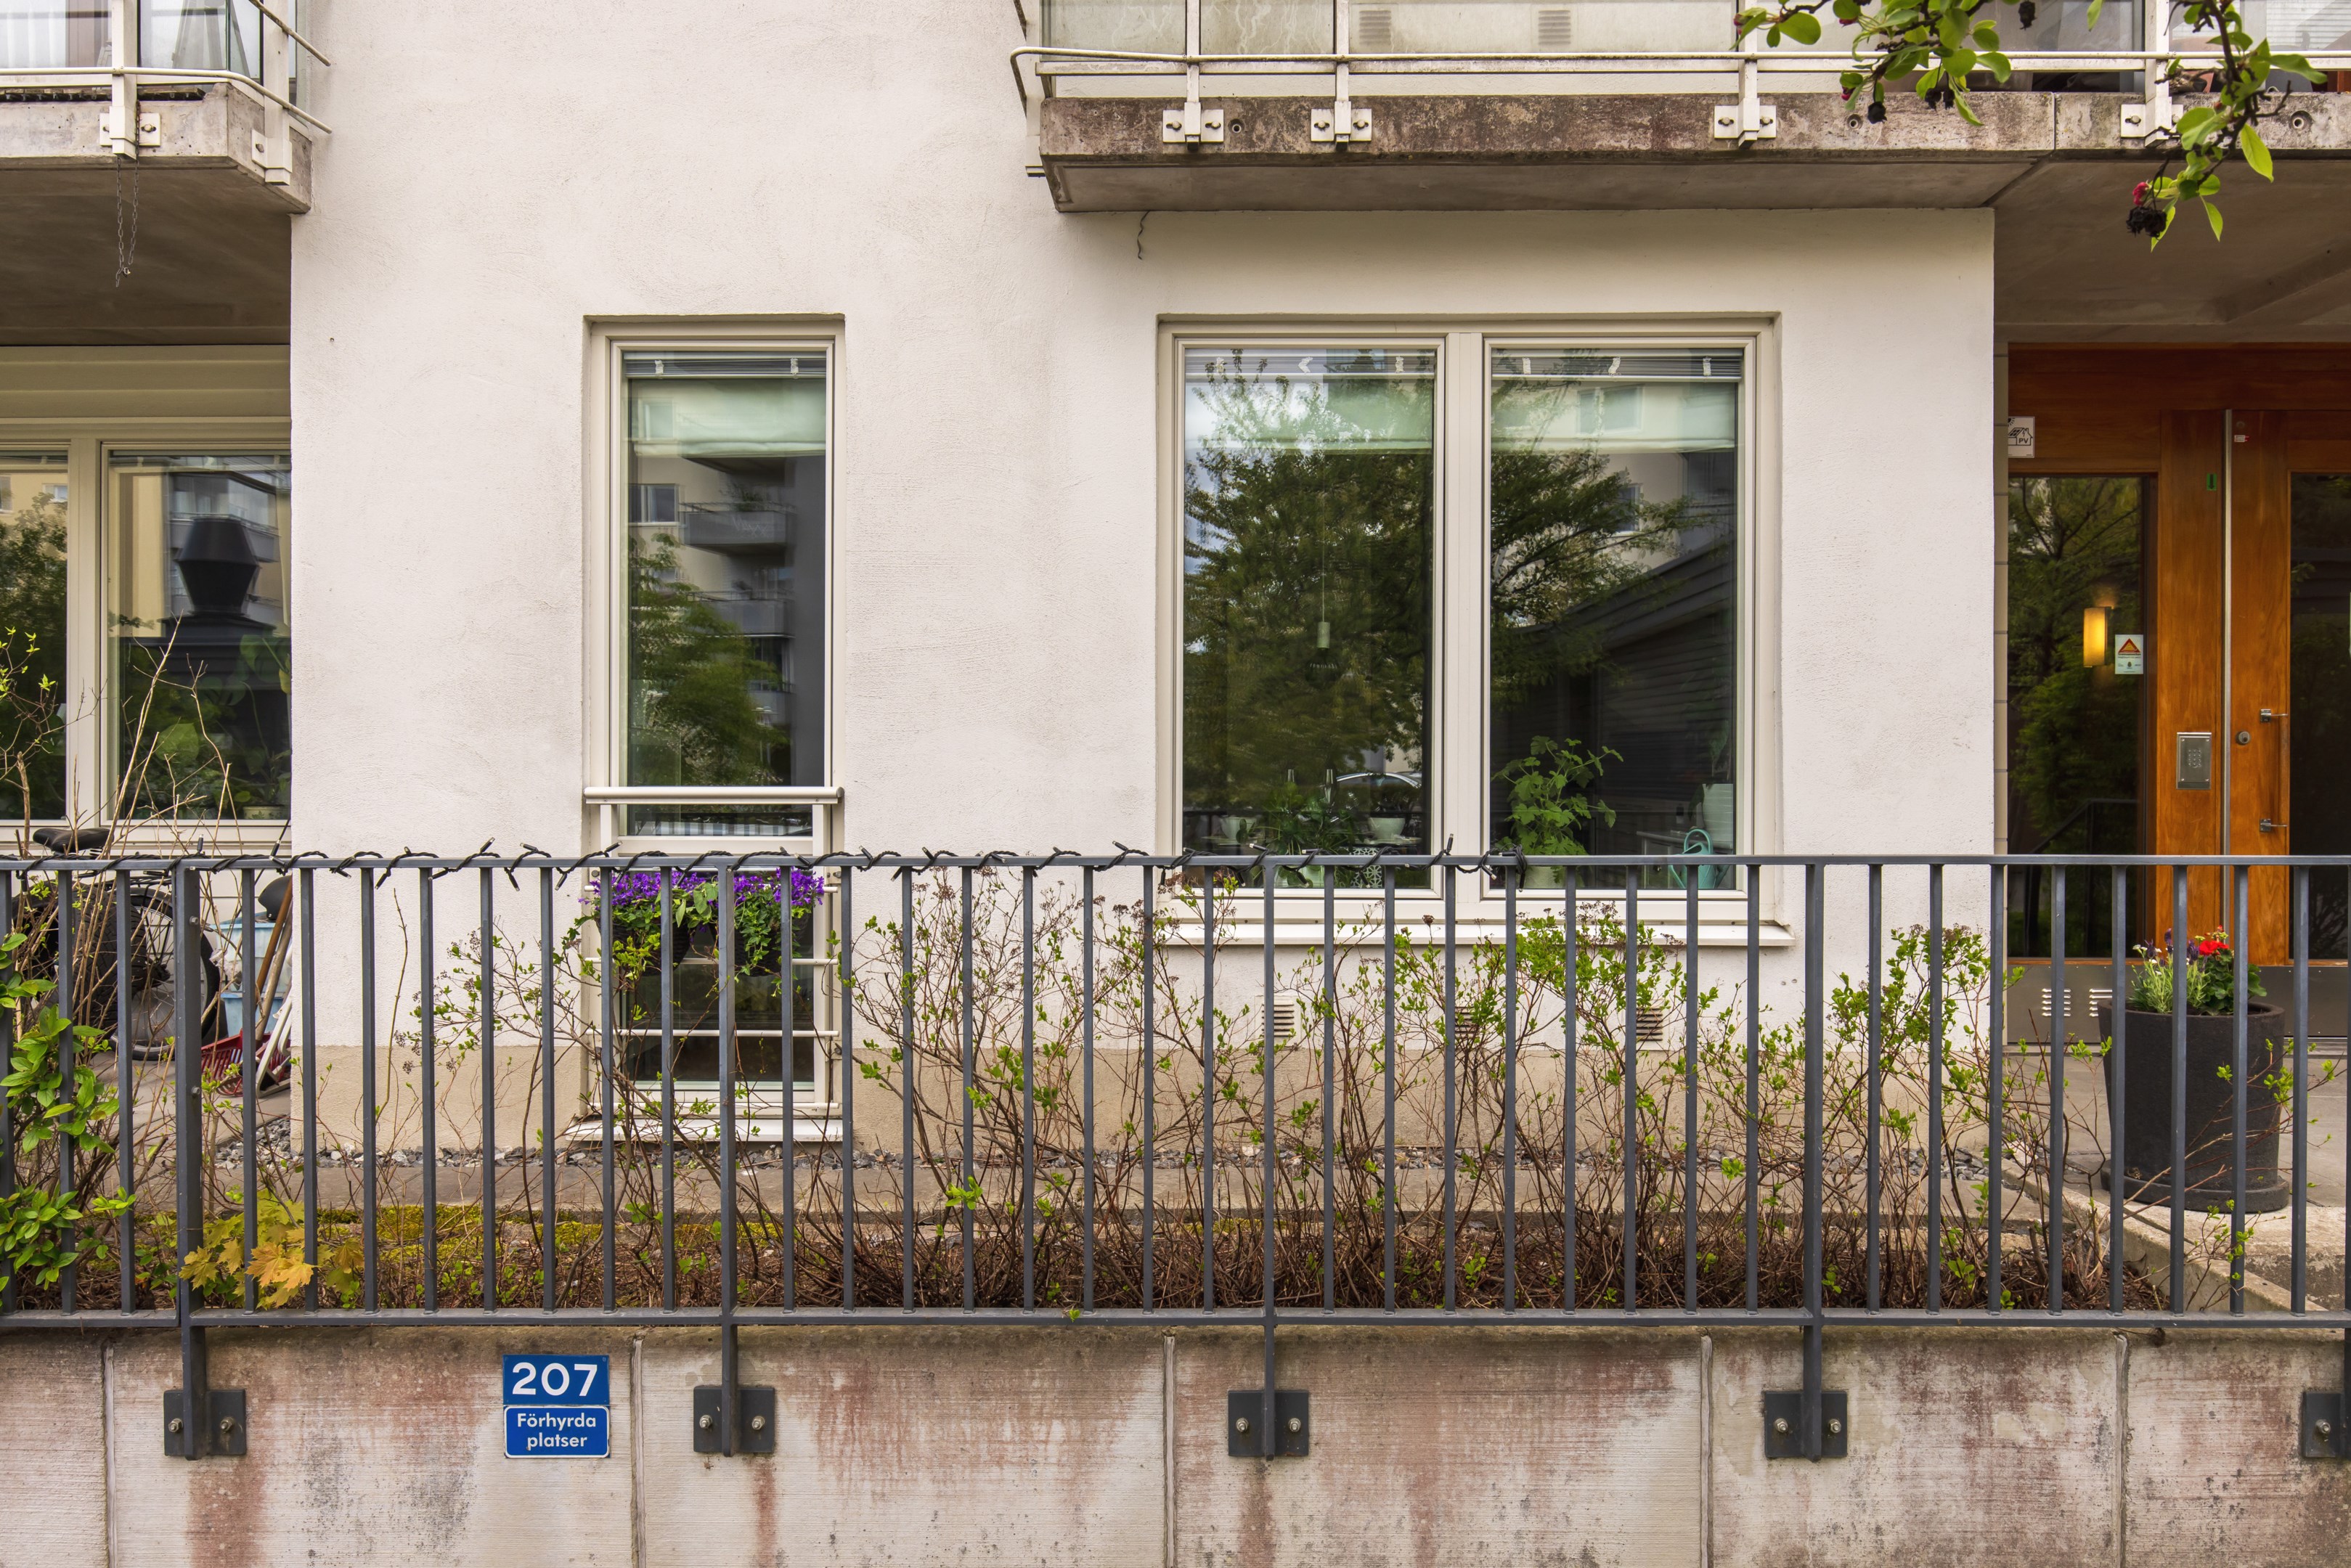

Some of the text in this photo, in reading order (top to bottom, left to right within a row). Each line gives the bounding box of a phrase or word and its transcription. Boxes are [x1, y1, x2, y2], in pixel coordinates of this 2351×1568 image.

[512, 1362, 598, 1397] 207
[518, 1412, 596, 1431] Förhyrda
[527, 1432, 587, 1450] platser
